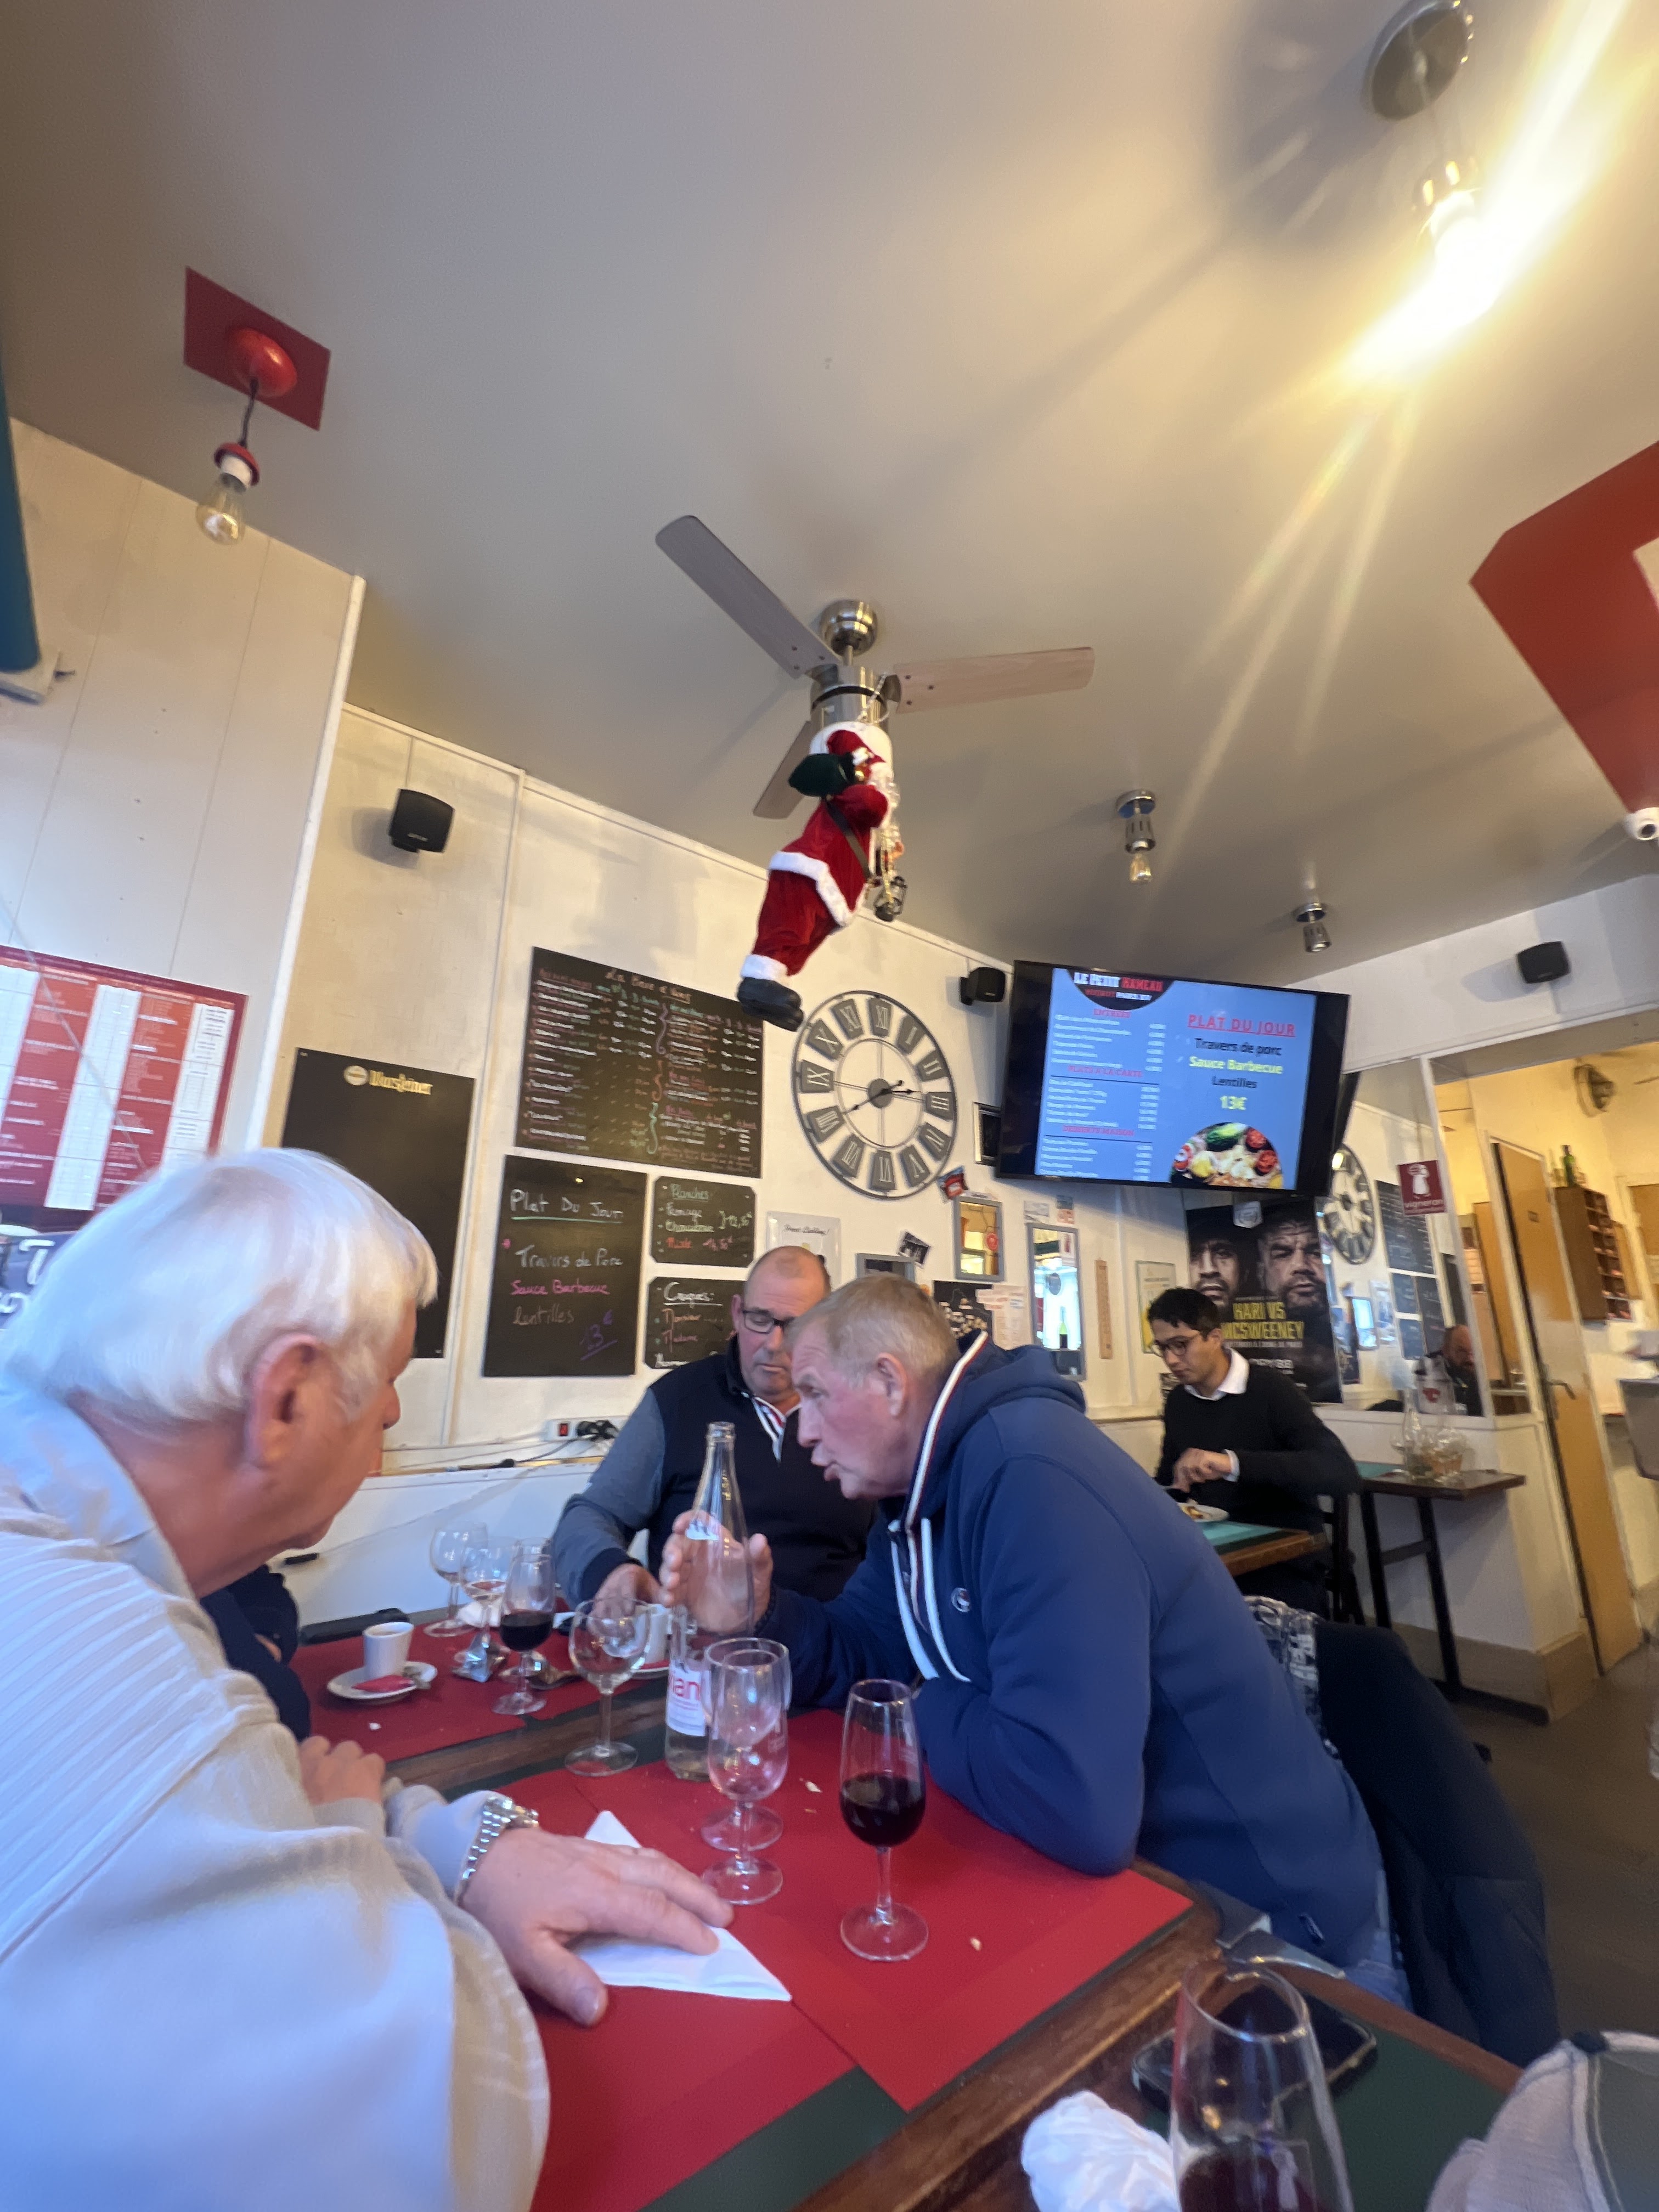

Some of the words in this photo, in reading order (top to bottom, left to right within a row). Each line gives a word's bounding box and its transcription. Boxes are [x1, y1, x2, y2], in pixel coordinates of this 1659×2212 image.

[1188, 1014, 1226, 1029] PLAT
[1231, 1018, 1252, 1032] DU
[1256, 1021, 1295, 1036] JOUR
[1194, 1037, 1238, 1052] Travers
[1240, 1042, 1254, 1053] de
[1256, 1045, 1282, 1057] porc
[1189, 1056, 1226, 1069] Sauce
[1227, 1059, 1283, 1074] Barbecue
[1211, 1076, 1258, 1088] Lentilles
[930, 1095, 949, 1111] III
[1220, 1095, 1248, 1110] 13€
[561, 1197, 580, 1214] Du
[575, 1251, 592, 1267] de
[596, 1248, 624, 1266] Porc
[511, 1279, 549, 1295] Sauce
[1266, 1301, 1286, 1319] VS
